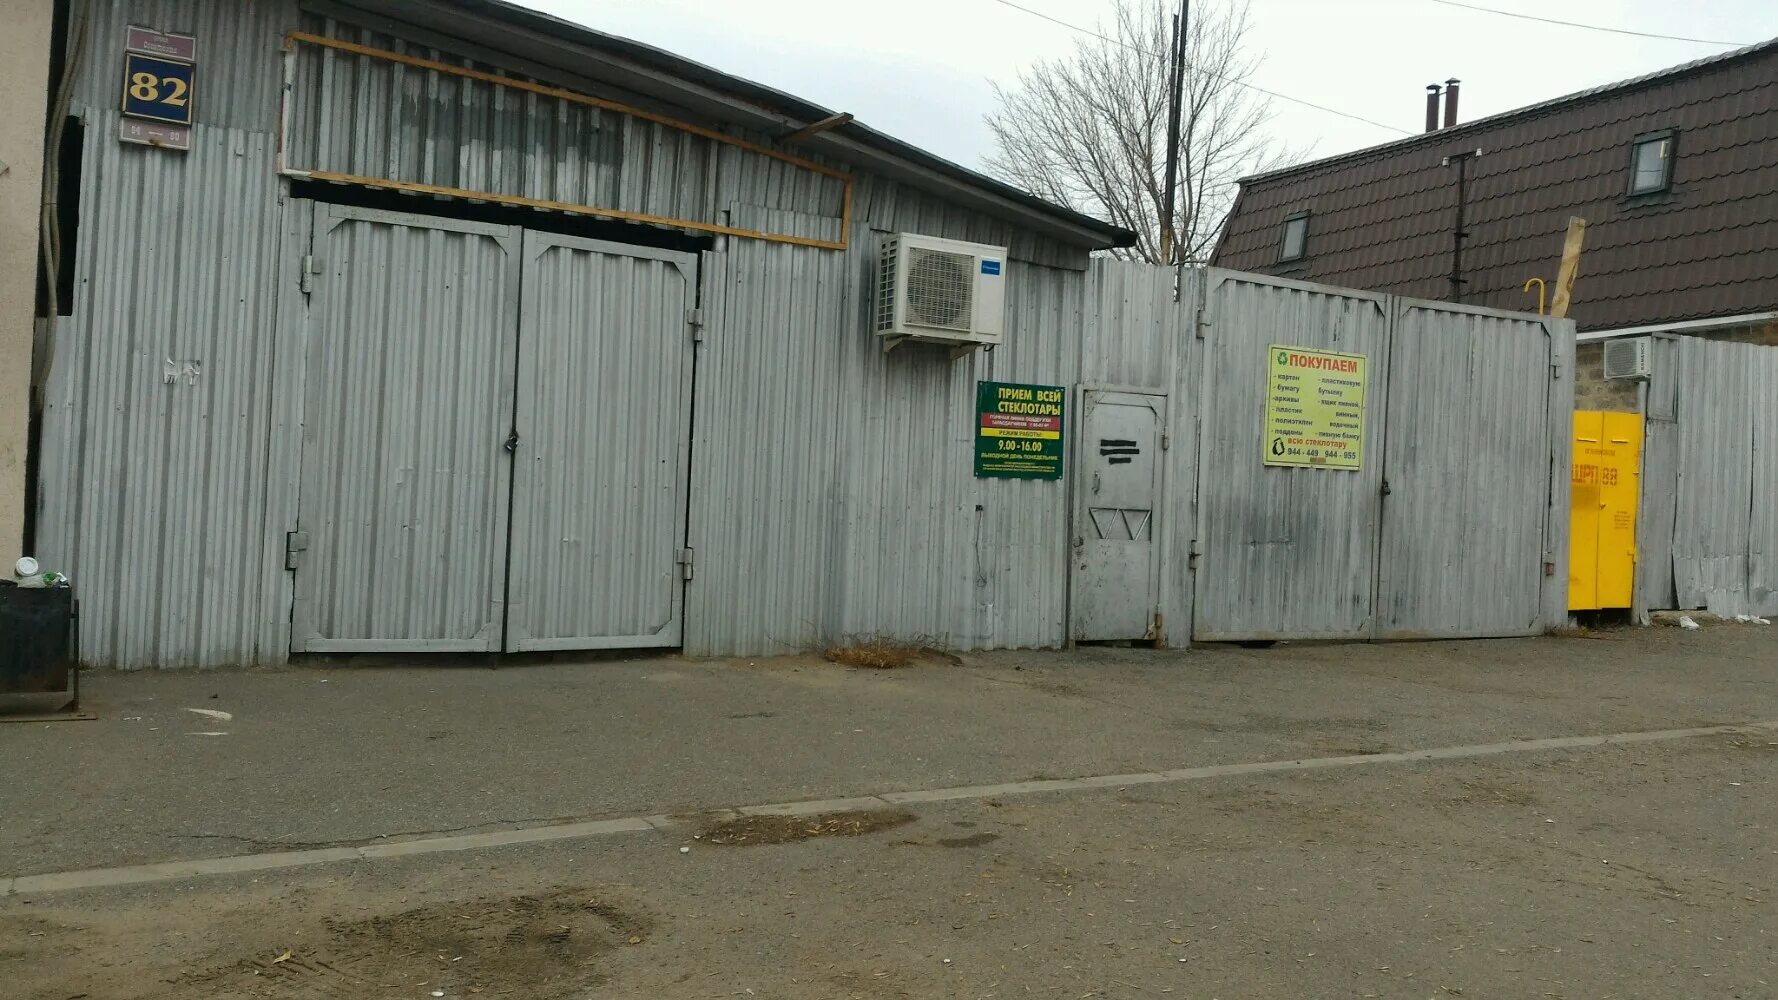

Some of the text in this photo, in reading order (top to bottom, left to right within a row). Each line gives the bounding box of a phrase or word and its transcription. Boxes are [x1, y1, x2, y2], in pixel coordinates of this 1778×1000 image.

[130, 72, 187, 106] 82
[1289, 354, 1357, 373] ПОКУПАЕМ
[1278, 374, 1300, 382] картон
[1322, 378, 1360, 388] пластиковую
[1277, 384, 1300, 393] бумагу
[1318, 387, 1343, 397] бутылку
[998, 387, 1060, 402] ПРИЕМ ВСЕЙ
[998, 401, 1060, 415] СТЕКЛОТАРЫ
[1275, 418, 1313, 426] полиэтилен
[1319, 431, 1360, 441] пивную банку
[1305, 440, 1348, 449] стеклотару
[1287, 448, 1301, 456] 944
[1306, 449, 1319, 457] 449
[1324, 450, 1338, 458] 944
